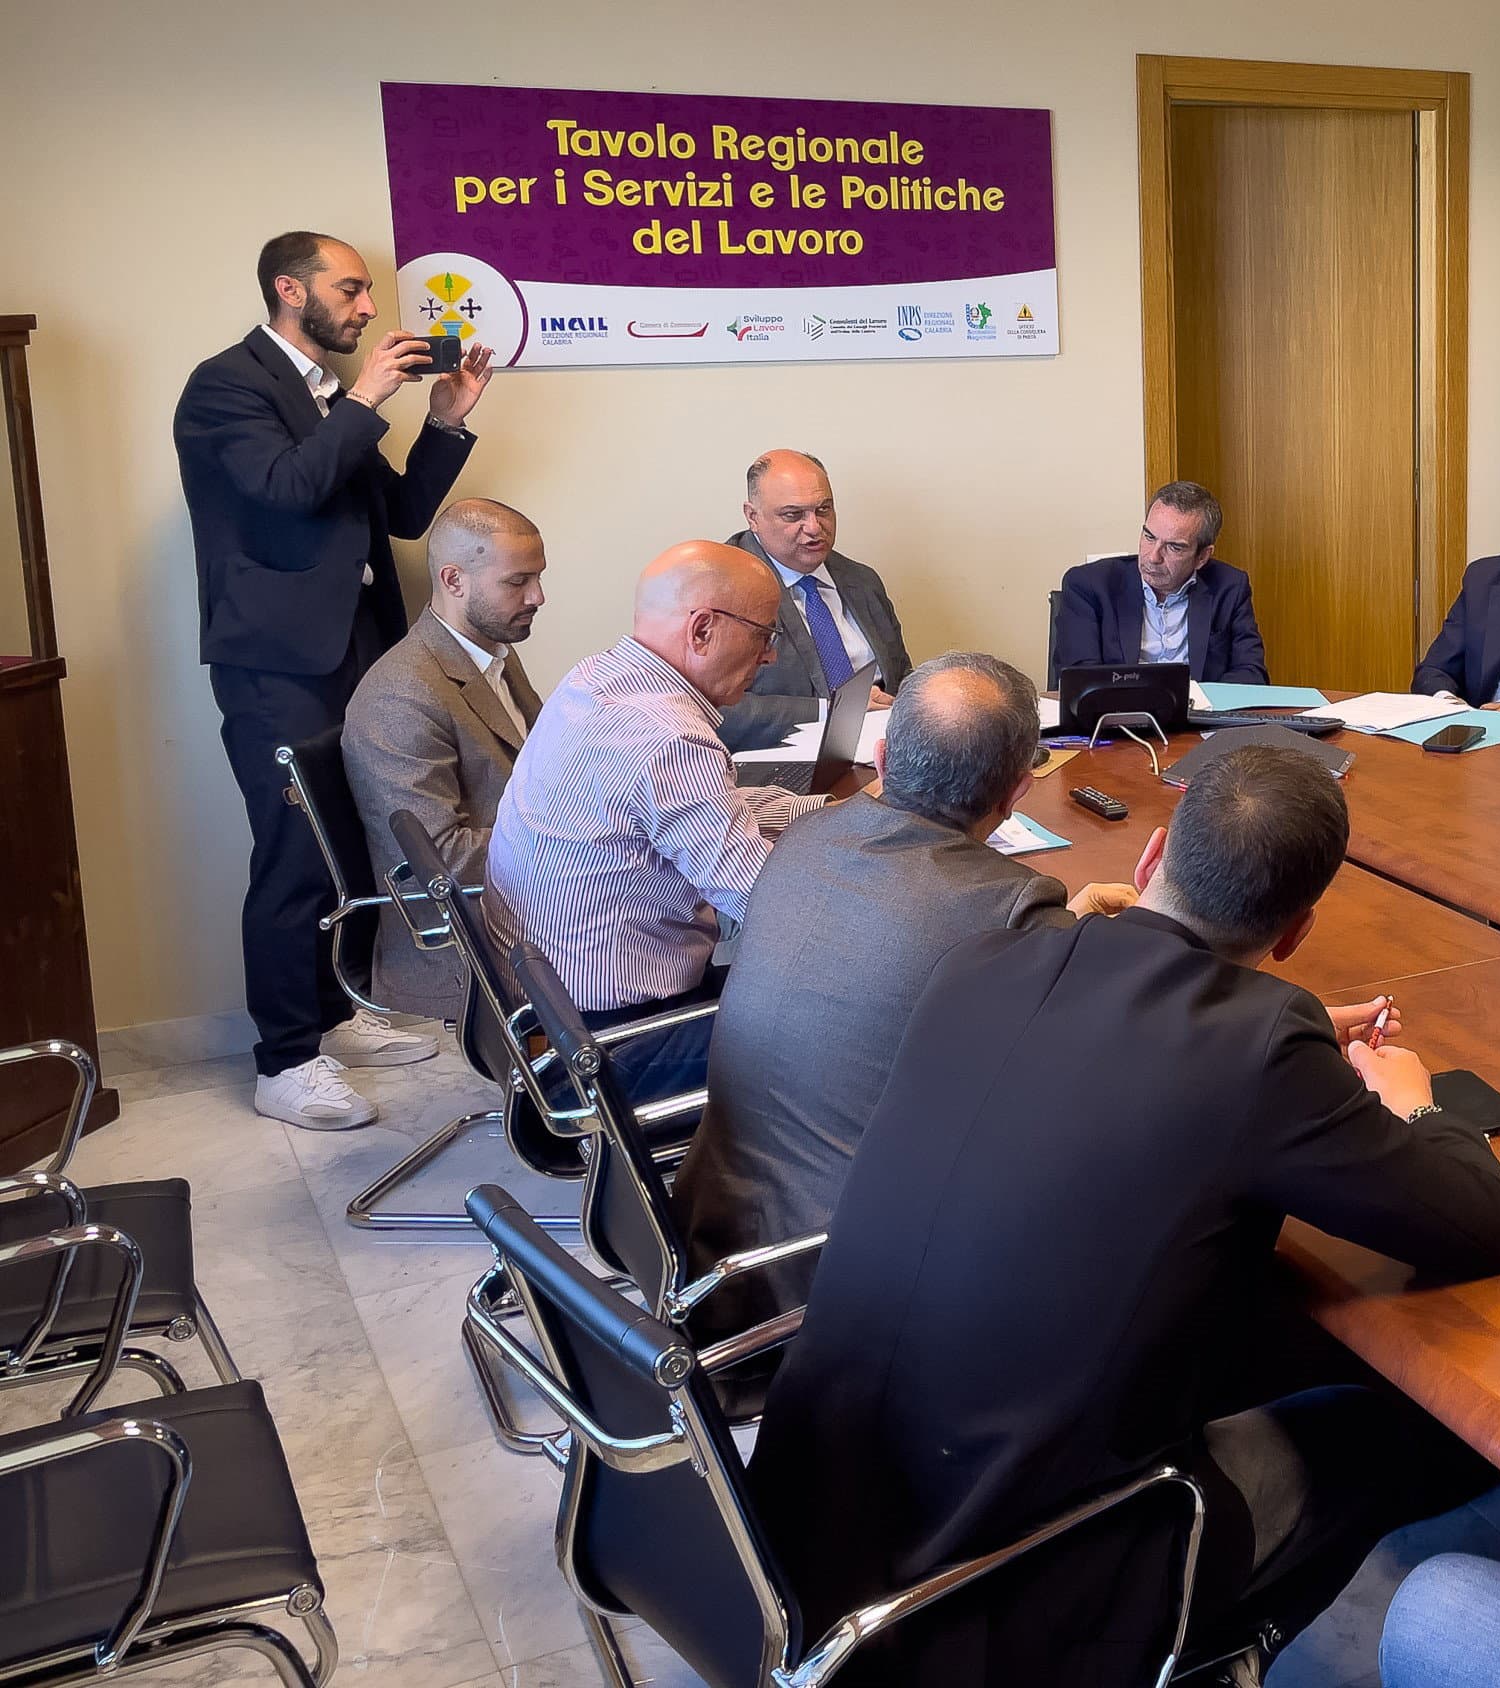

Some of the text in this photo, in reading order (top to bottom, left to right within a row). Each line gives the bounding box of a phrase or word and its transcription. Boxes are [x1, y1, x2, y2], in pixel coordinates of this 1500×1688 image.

[547, 119, 924, 171] Tavolo Regionale
[454, 168, 1004, 213] per i Servizi e le Politiche
[632, 219, 864, 256] del Lavoro
[541, 317, 608, 331] INAIL
[743, 315, 783, 324] Sviluppo
[897, 305, 922, 326] INPS
[753, 324, 785, 332] Lavoro
[746, 333, 770, 342] Italia
